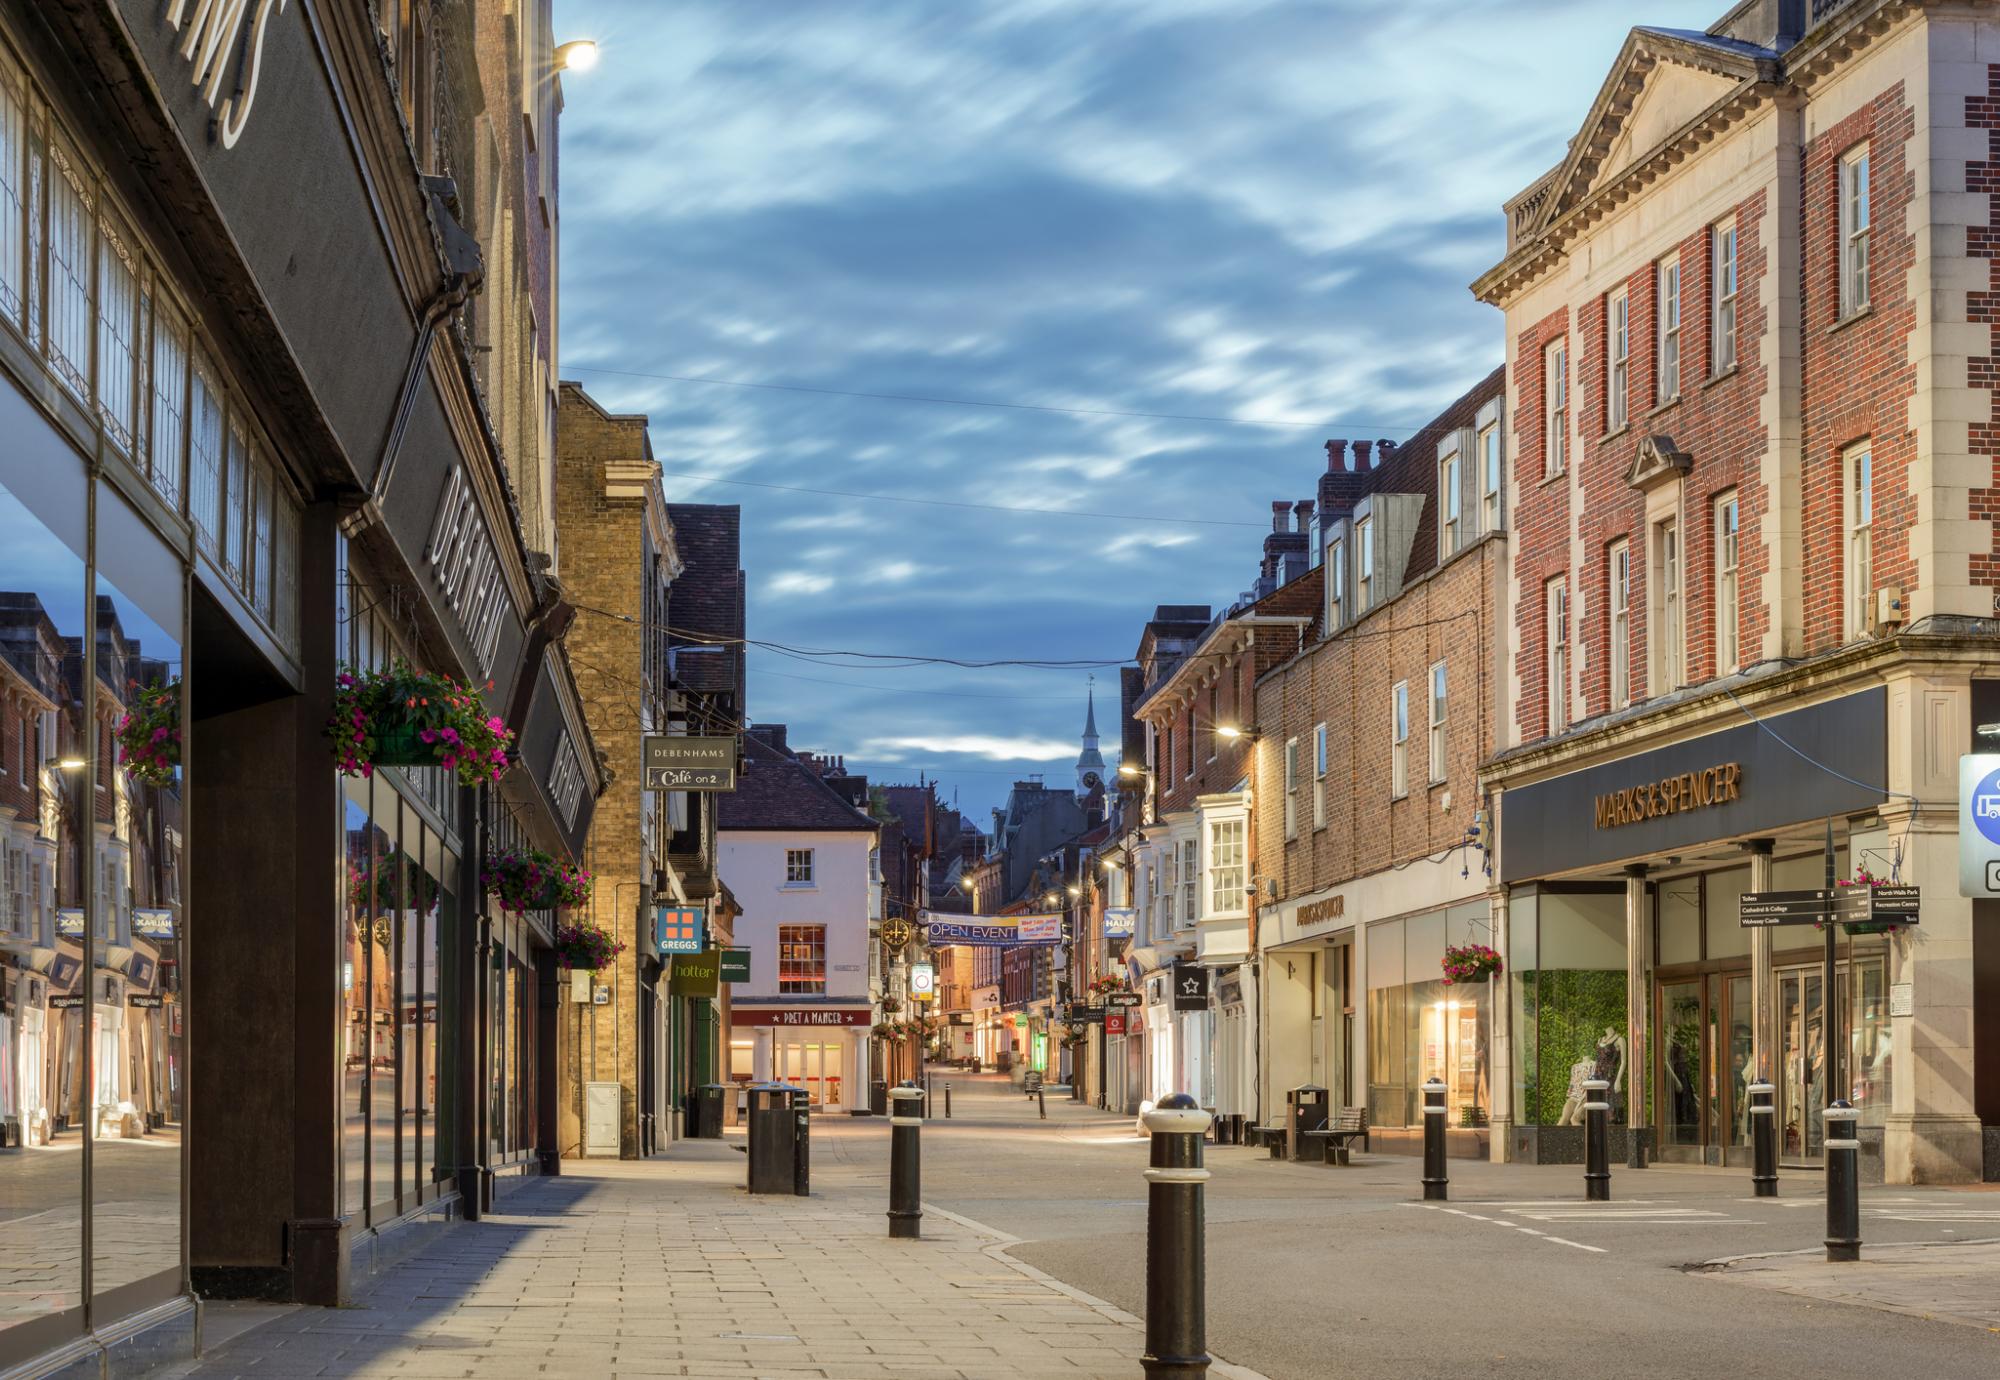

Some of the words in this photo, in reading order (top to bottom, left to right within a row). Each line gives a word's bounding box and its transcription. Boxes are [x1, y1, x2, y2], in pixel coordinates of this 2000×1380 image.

[654, 749, 725, 758] DEBENHAMS
[661, 770, 692, 786] Café
[695, 776, 709, 784] on
[710, 775, 717, 784] 2
[1105, 919, 1135, 927] HALIFA
[930, 923, 968, 937] OPEN
[972, 926, 1017, 938] EVENT
[661, 940, 698, 950] GREGGS
[675, 965, 714, 978] hotter
[783, 1011, 802, 1024] PRET
[804, 1012, 810, 1023] A
[811, 1012, 842, 1024] MANGER
